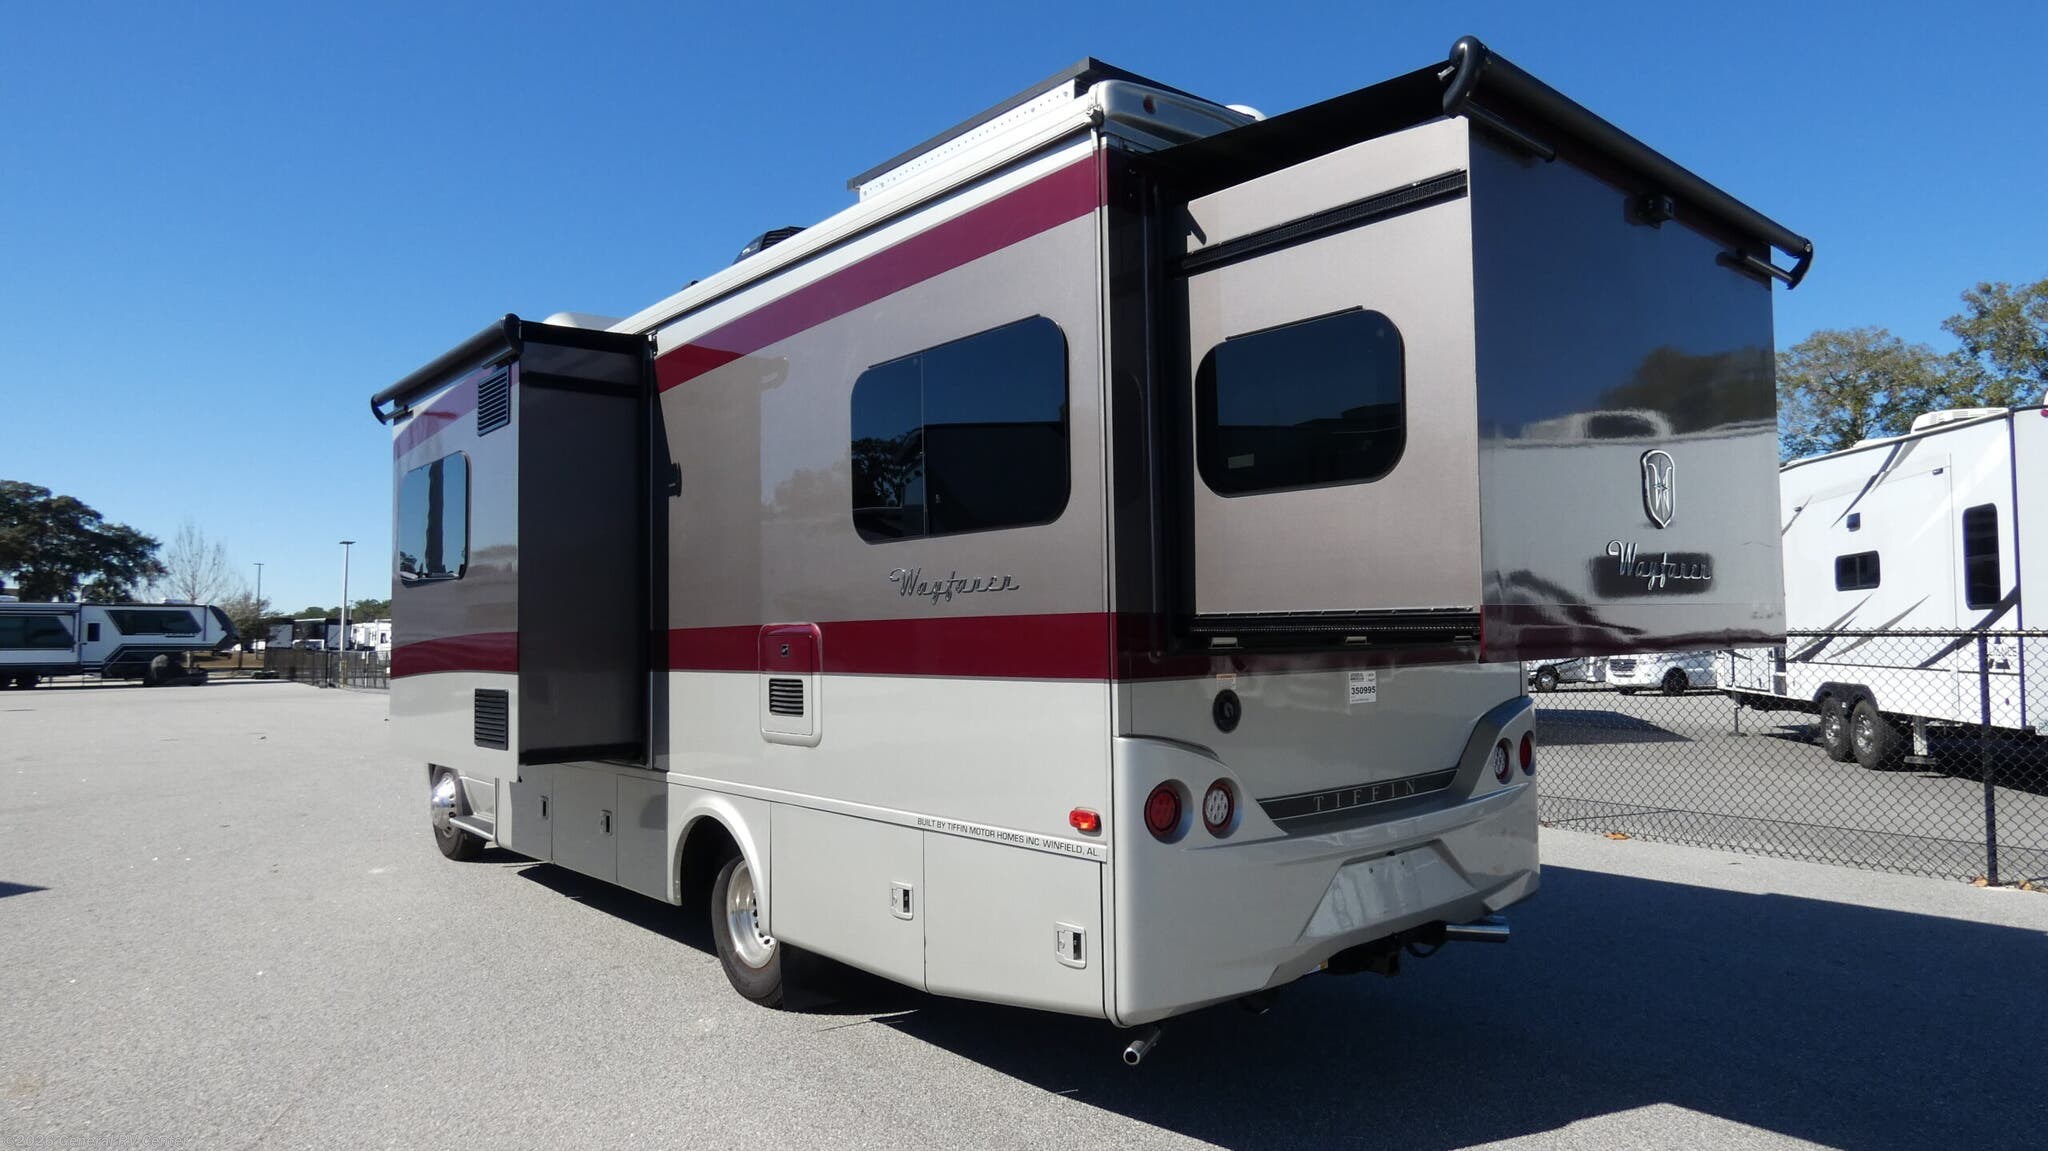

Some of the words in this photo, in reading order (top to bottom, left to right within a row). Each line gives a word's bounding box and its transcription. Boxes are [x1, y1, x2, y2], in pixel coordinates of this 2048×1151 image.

[1606, 540, 1712, 591] Wayfarer
[889, 567, 1020, 606] Wayfarer
[1351, 685, 1376, 696] 350995
[1313, 780, 1416, 812] TIFFIN
[917, 817, 936, 827] BUILT
[936, 820, 946, 829] BY
[947, 822, 968, 833] TIFFIN
[969, 826, 995, 838] MOTOR
[997, 830, 1024, 844] HOMES
[1042, 839, 1085, 855] WINFIELD,
